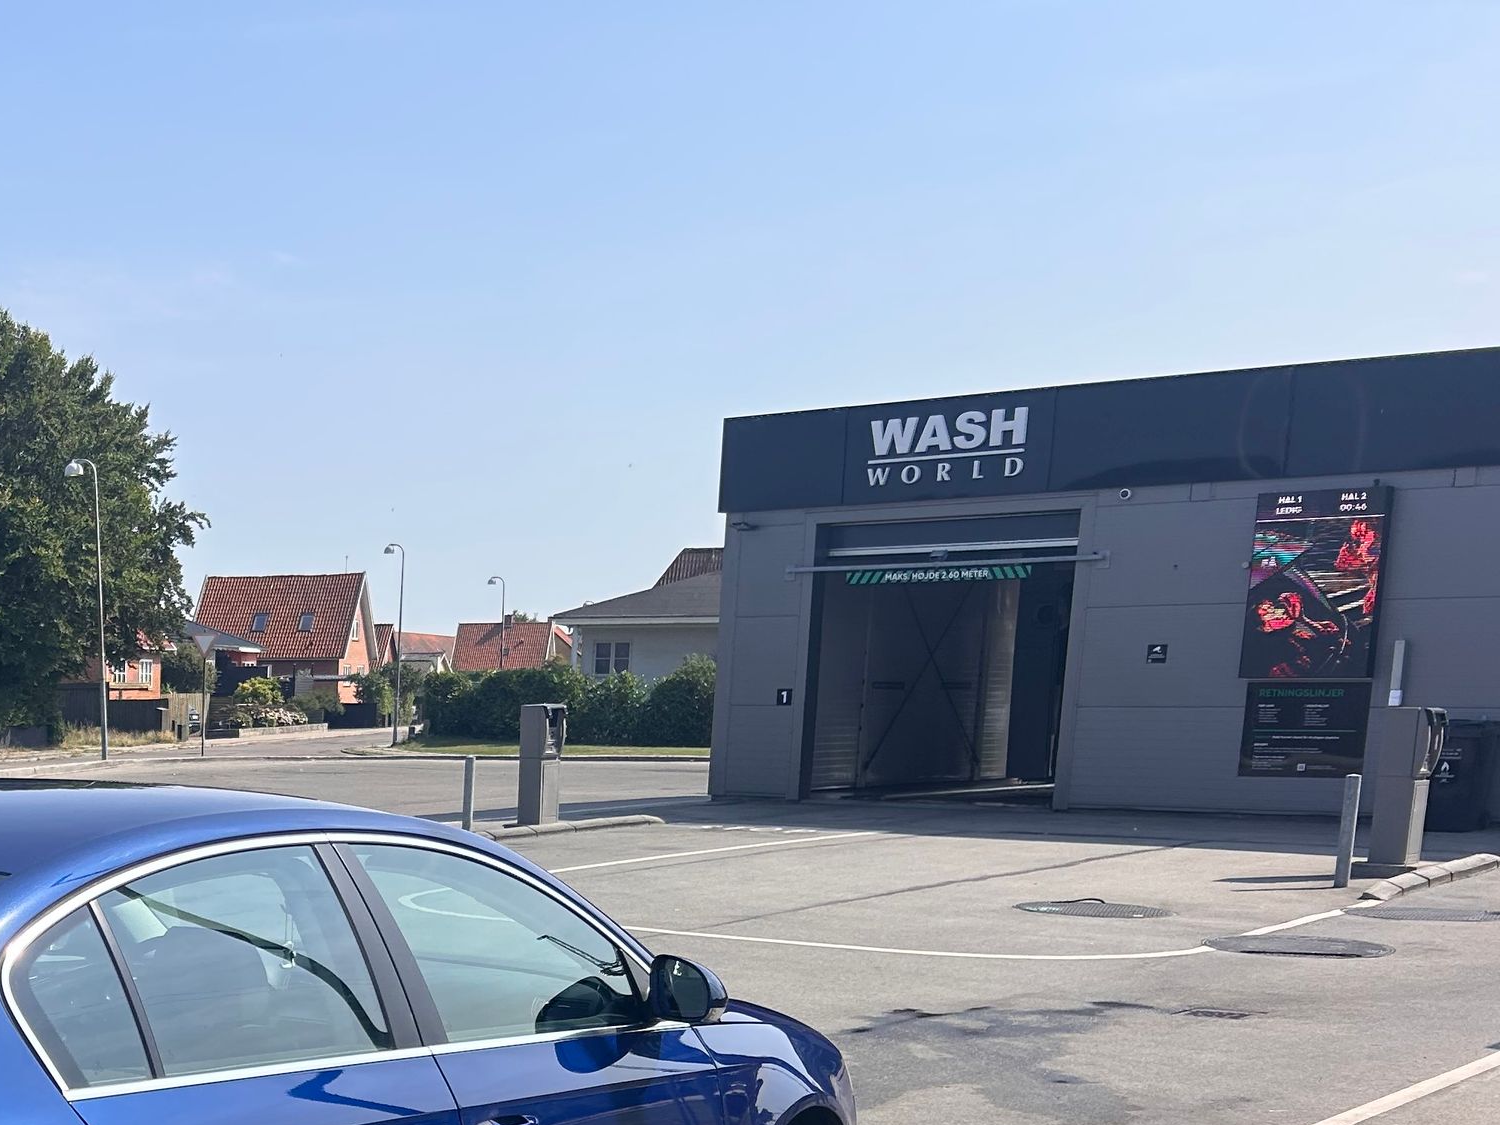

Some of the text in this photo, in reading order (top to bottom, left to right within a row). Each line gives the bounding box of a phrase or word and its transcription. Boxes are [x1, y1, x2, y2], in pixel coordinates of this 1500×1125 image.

[871, 407, 1029, 456] WASH
[867, 457, 1024, 487] WORLD
[1278, 496, 1296, 504] HAL
[1341, 492, 1367, 501] HAL 2
[961, 569, 988, 578] METER
[781, 691, 787, 704] 1
[1259, 688, 1345, 698] RETNINGSLINJER
